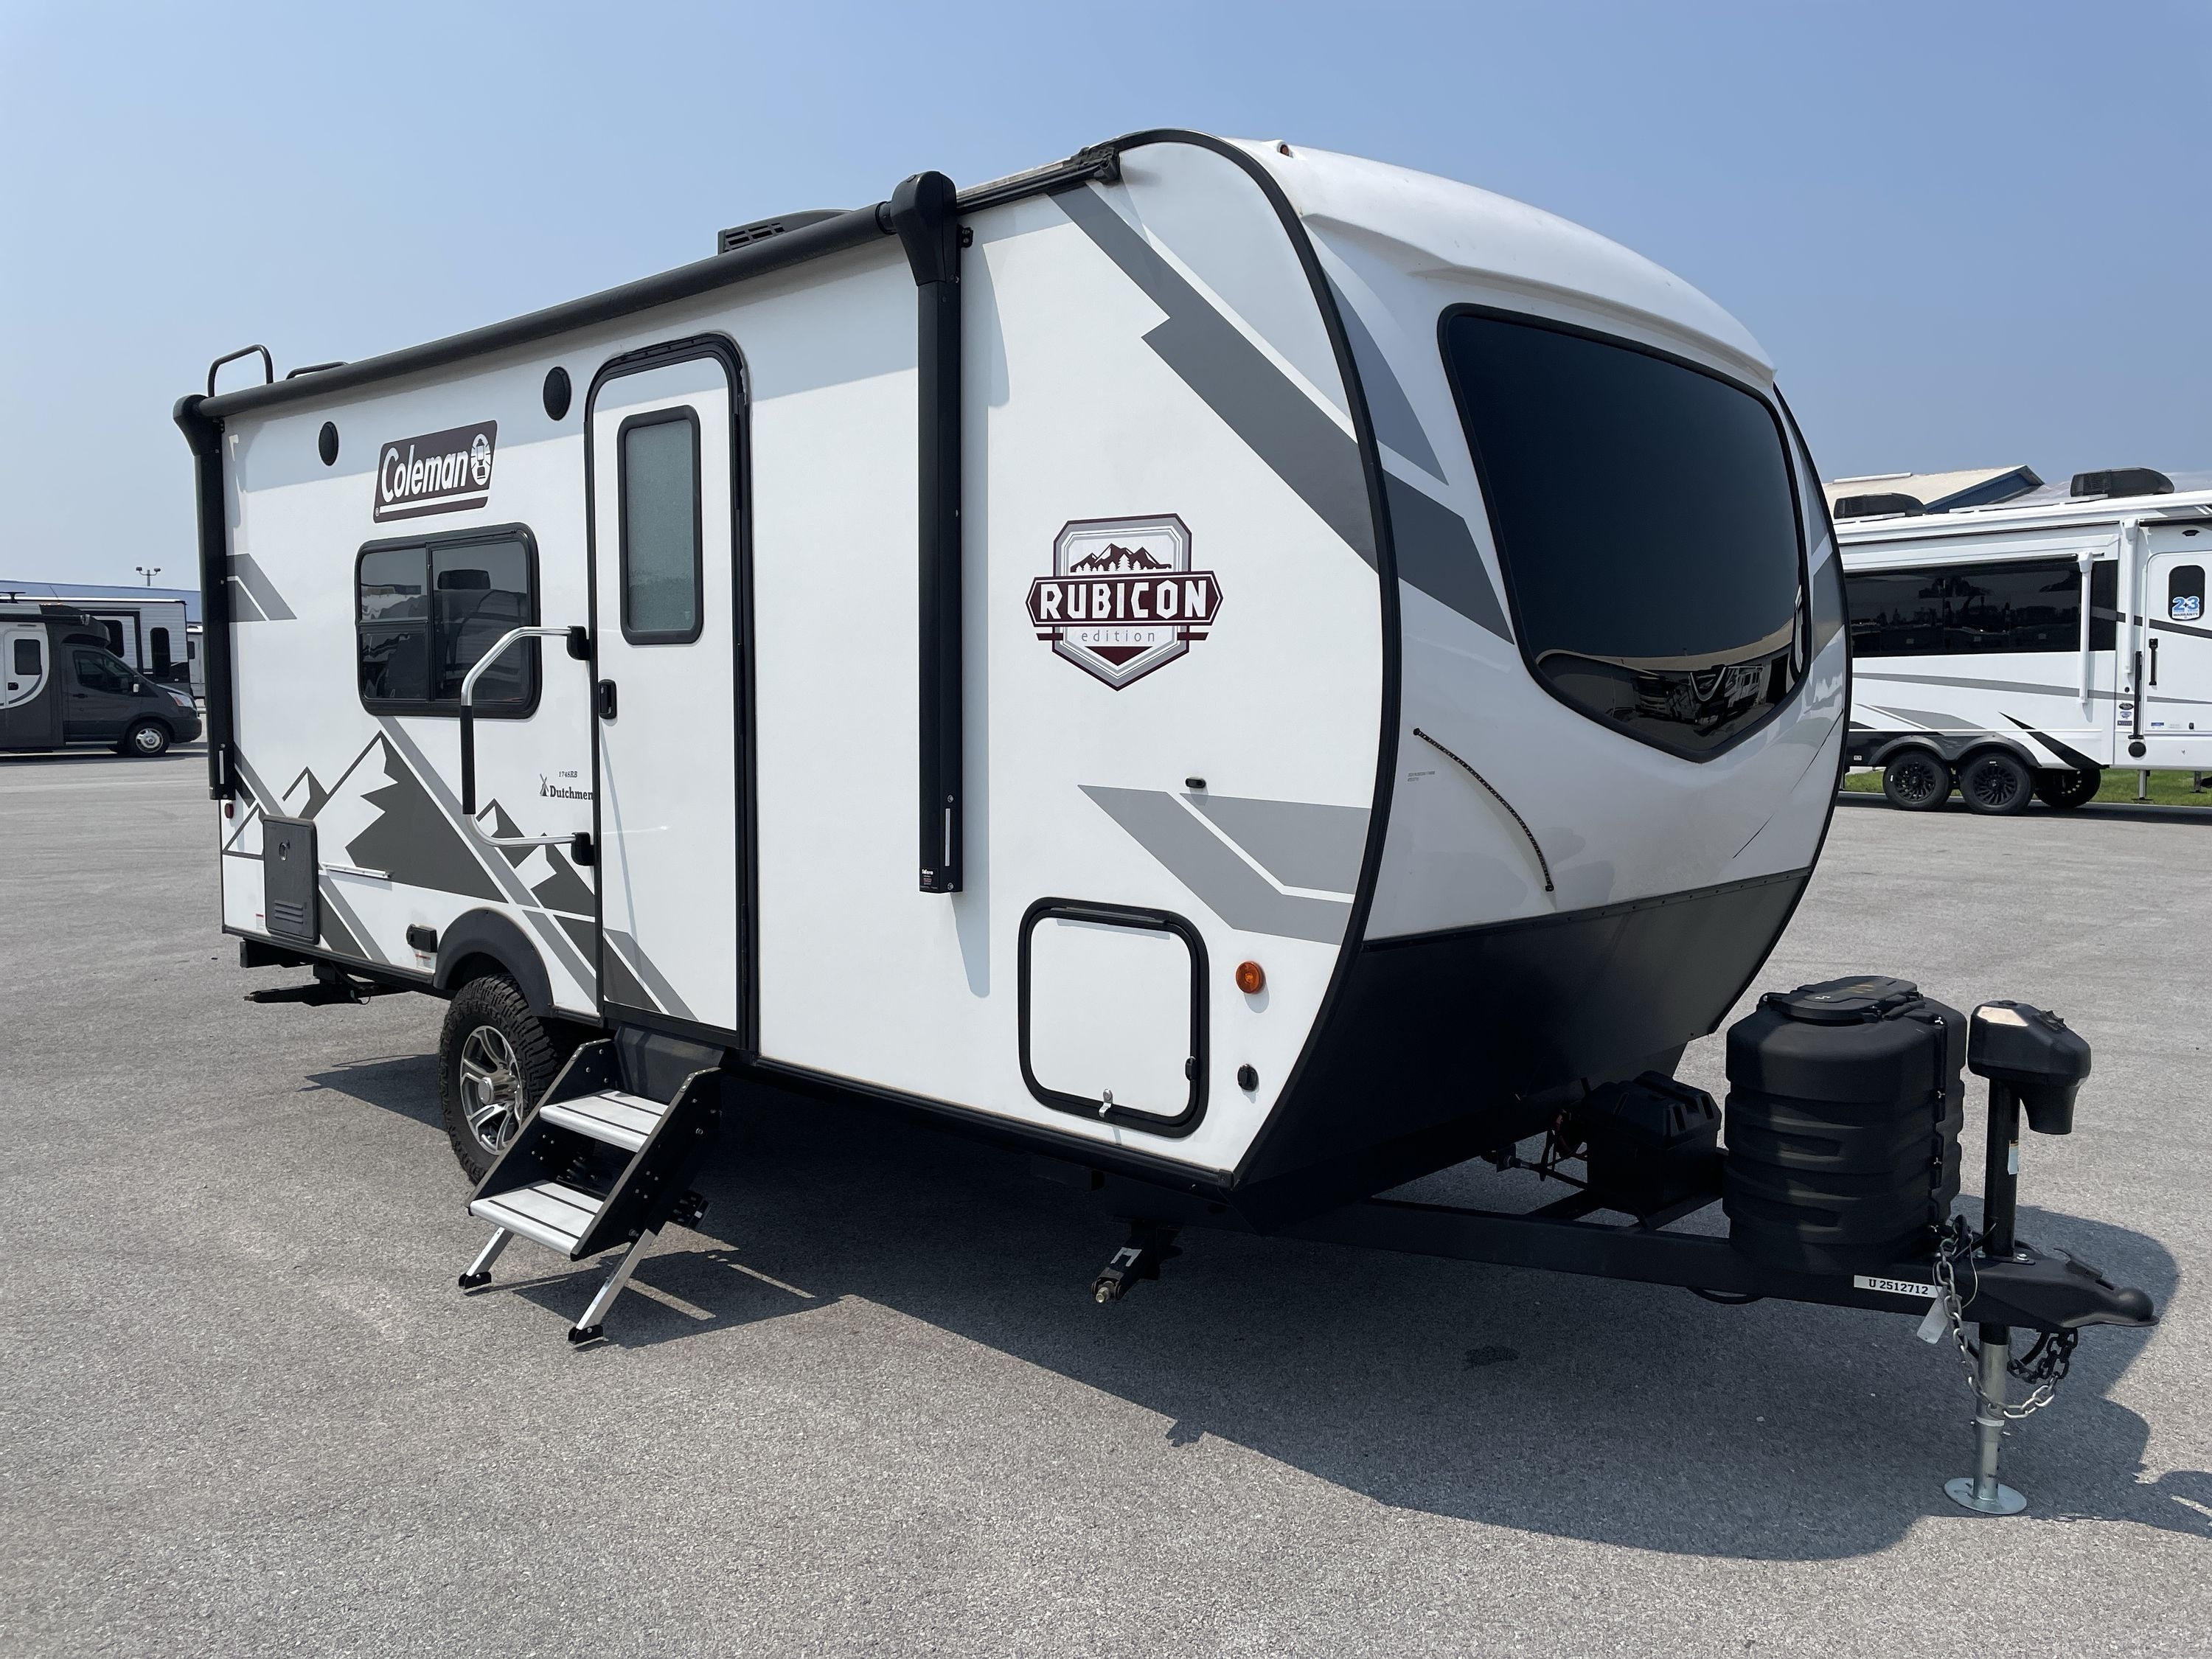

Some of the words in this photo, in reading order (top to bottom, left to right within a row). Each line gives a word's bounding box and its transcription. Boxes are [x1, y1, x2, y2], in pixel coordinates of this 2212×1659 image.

[381, 444, 469, 503] Coleman
[1040, 580, 1207, 619] RUBICON
[1081, 629, 1155, 643] edition
[549, 785, 594, 800] Dutchmen
[1868, 1279, 1877, 1288] U
[1879, 1280, 1929, 1295] 2512712
